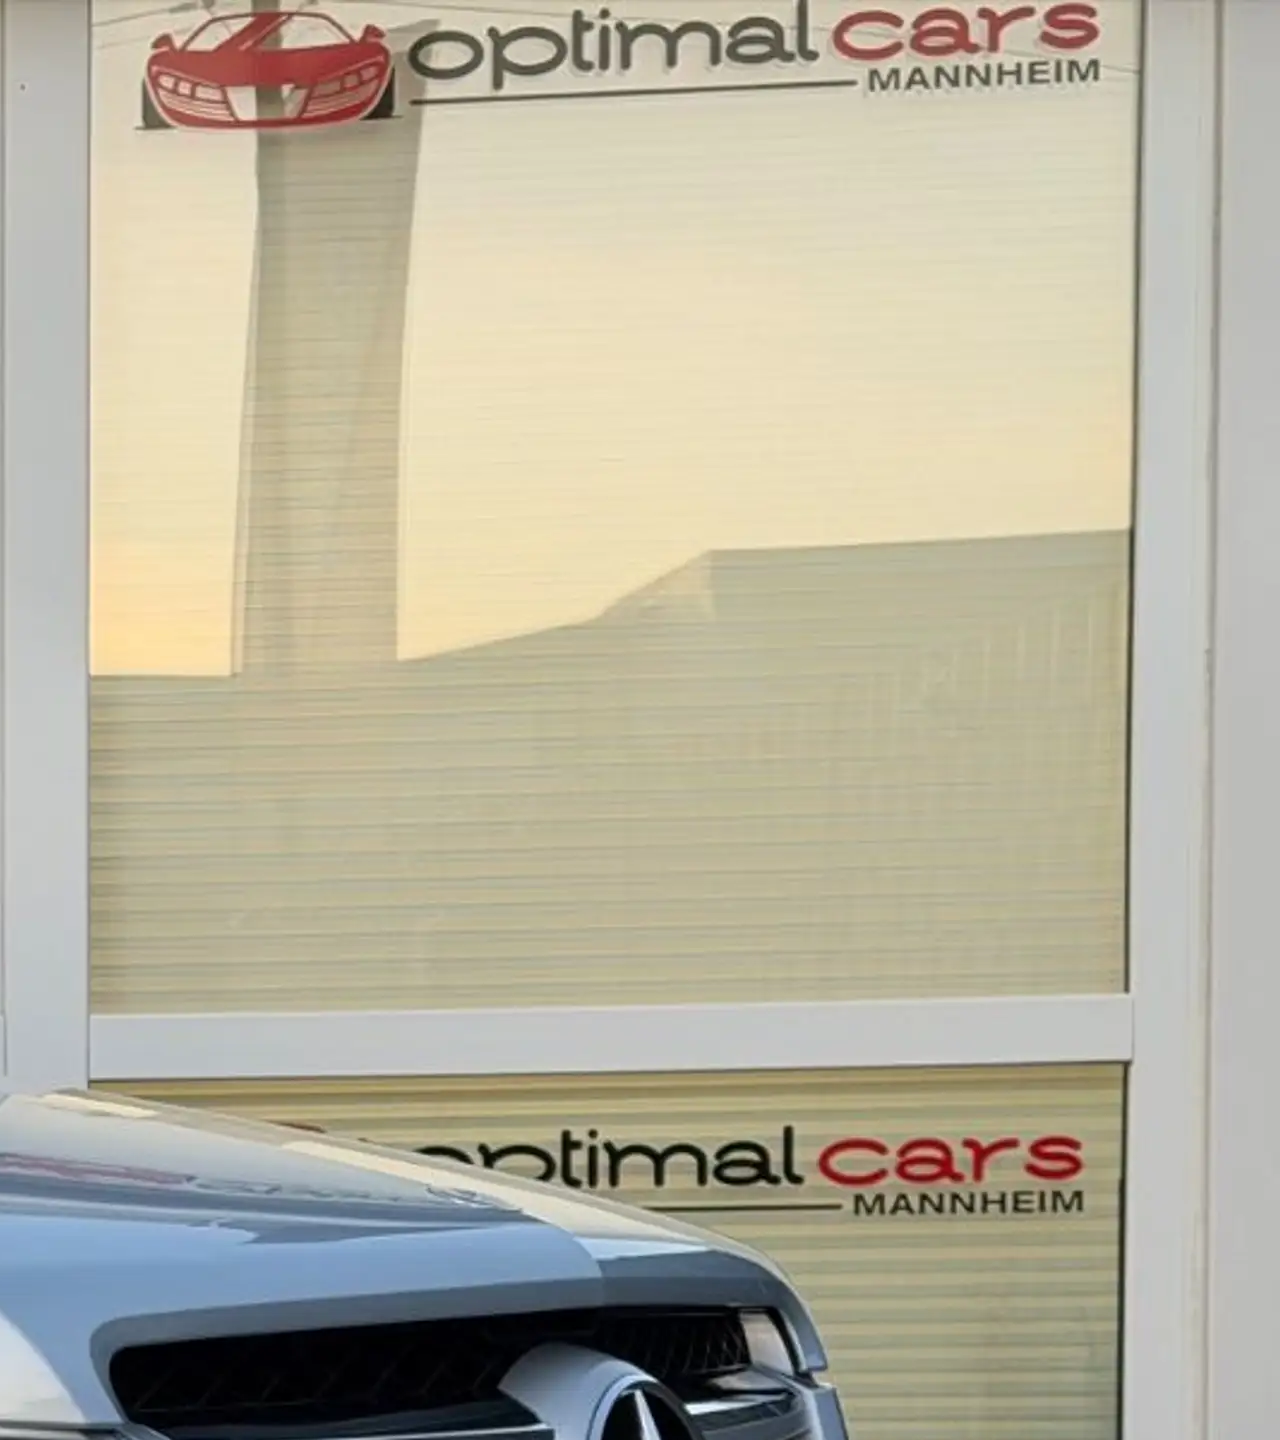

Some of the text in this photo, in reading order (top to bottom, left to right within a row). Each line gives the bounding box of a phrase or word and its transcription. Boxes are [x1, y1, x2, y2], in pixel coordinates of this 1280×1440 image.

[832, 2, 1100, 61] cars
[869, 58, 1101, 92] MANNHEIM
[819, 1136, 1084, 1187] cars
[853, 1190, 1085, 1217] MANNHEIM
